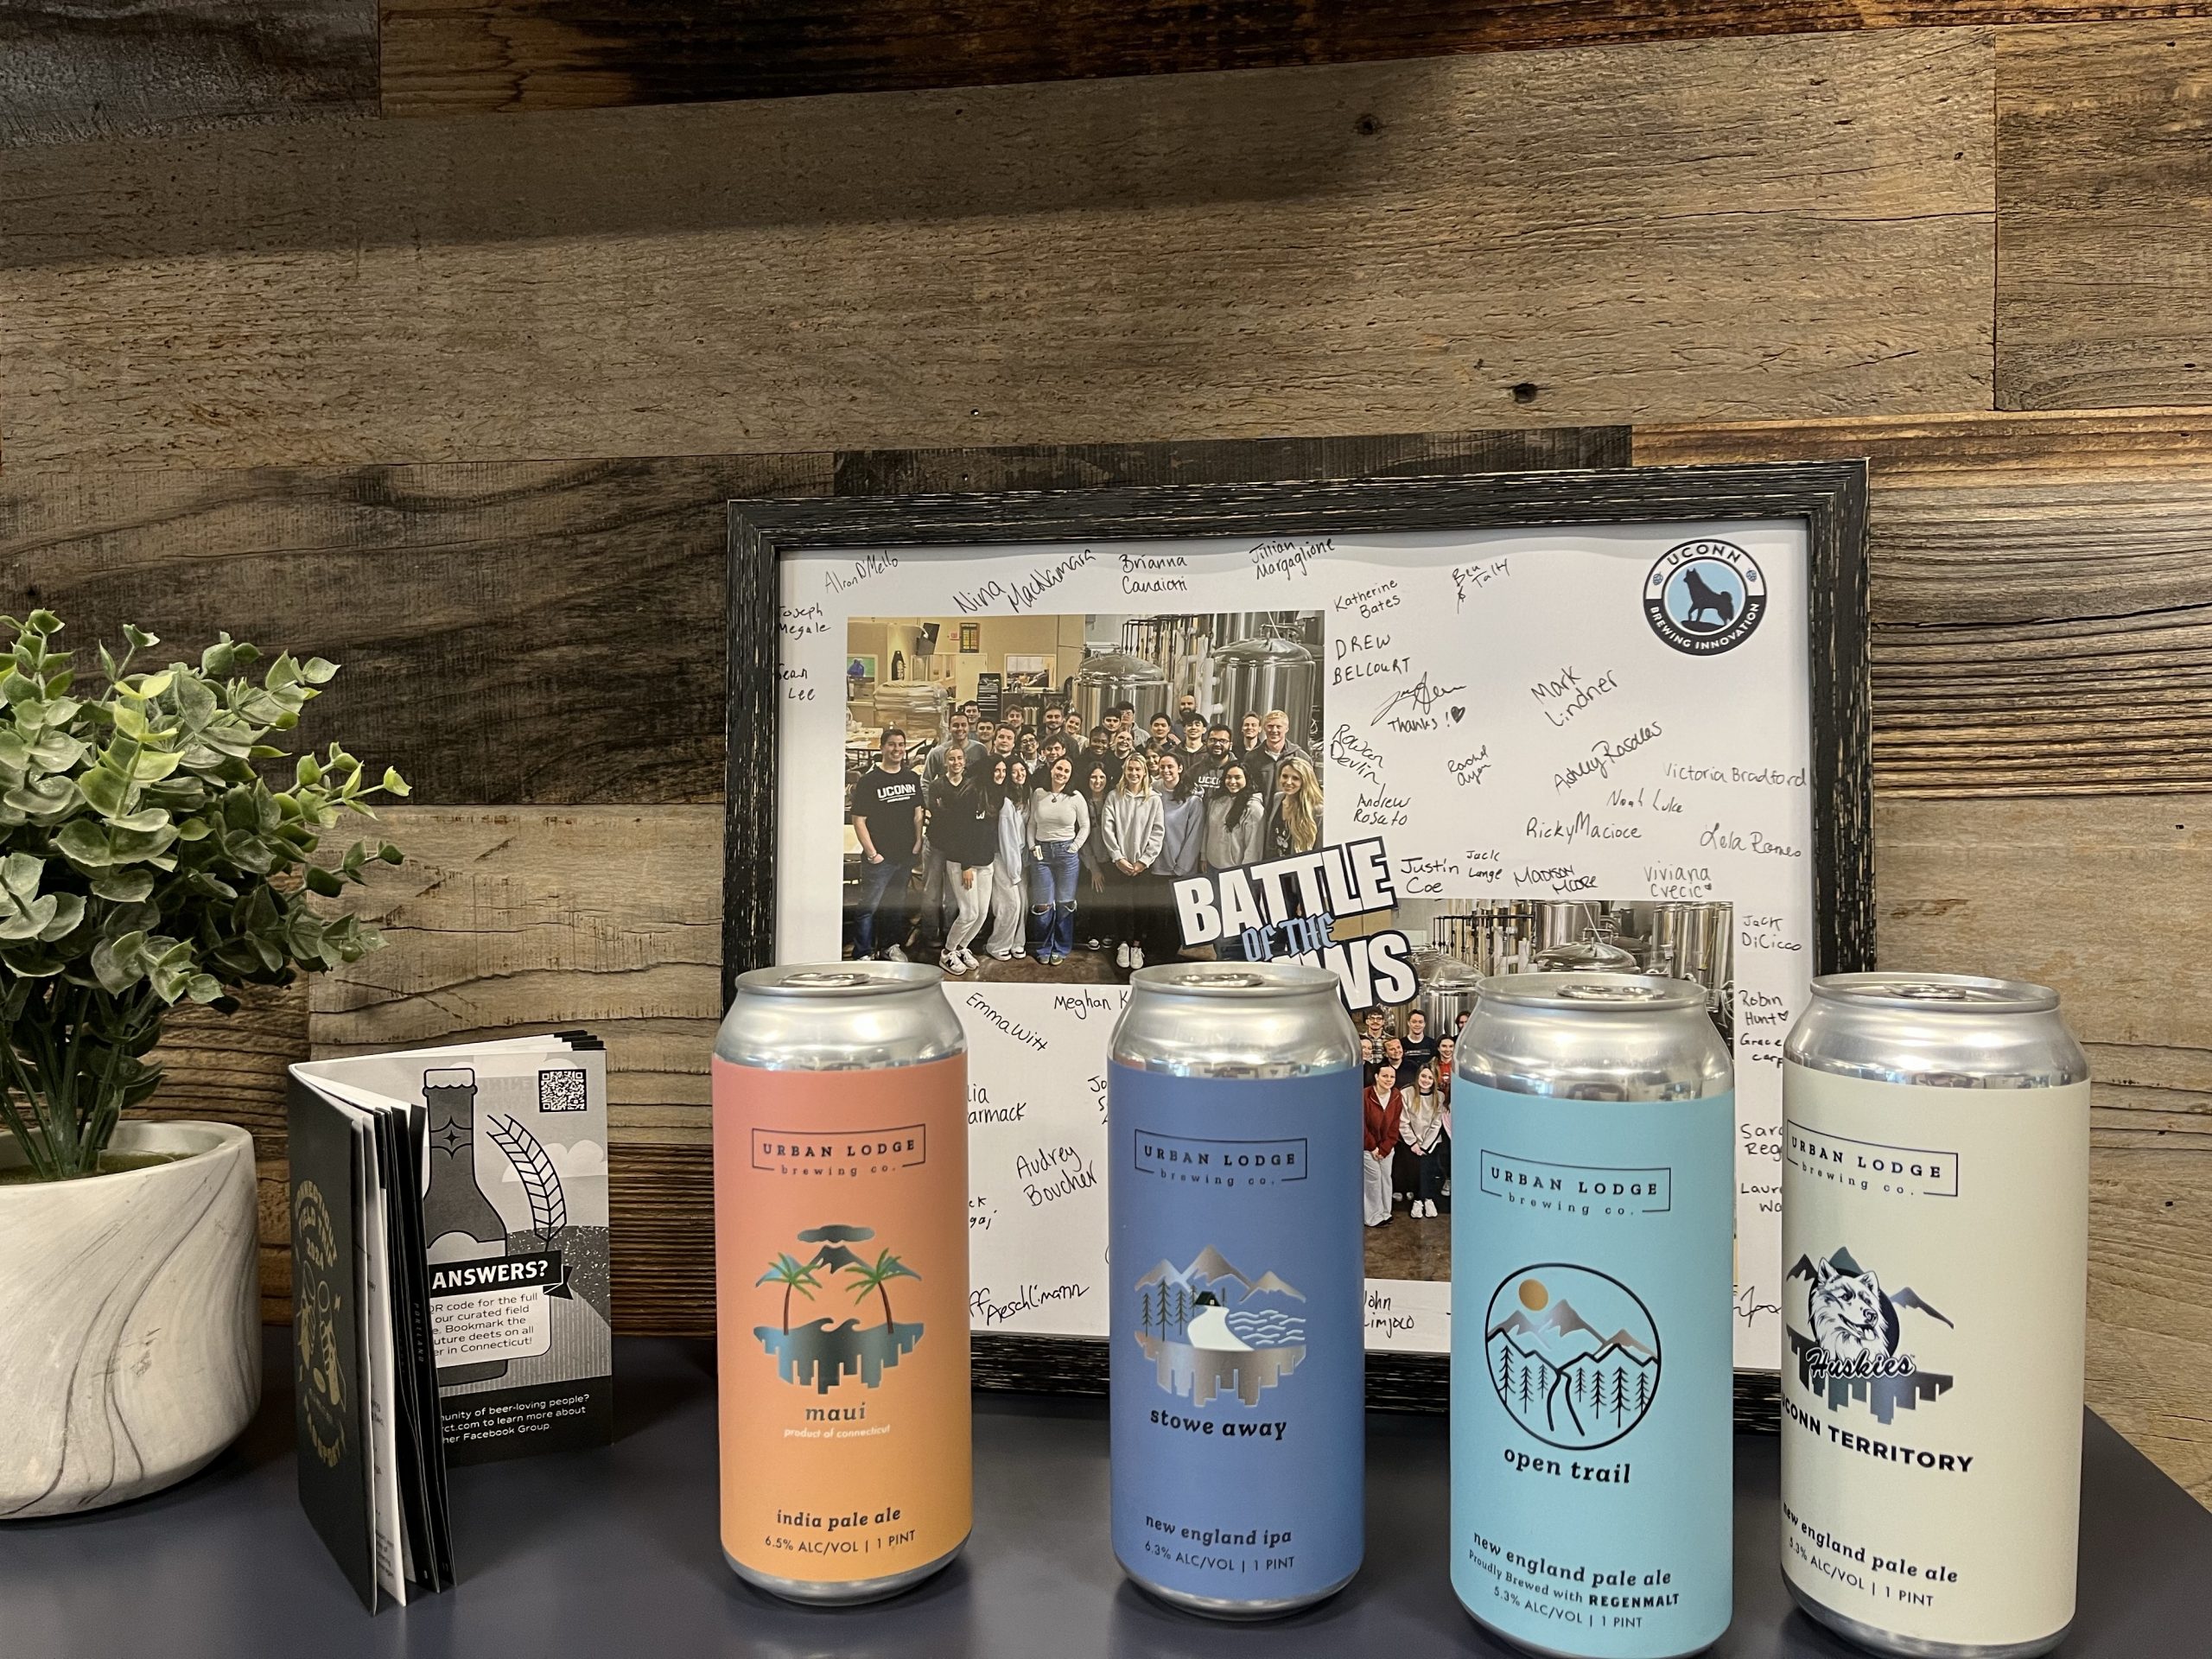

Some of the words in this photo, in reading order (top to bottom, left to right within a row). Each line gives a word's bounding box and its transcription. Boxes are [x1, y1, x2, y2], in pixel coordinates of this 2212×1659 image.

[1119, 554, 1187, 573] Brianna
[1667, 544, 1741, 565] UCONN
[953, 581, 1007, 613] Nina
[1334, 580, 1397, 612] Katherine
[1360, 594, 1400, 619] Bates
[779, 602, 823, 620] oseph
[1650, 607, 1691, 647] BREWING
[1695, 603, 1760, 649] INNOVATION
[1336, 634, 1390, 660] DREW
[789, 688, 816, 701] Lee
[1530, 666, 1581, 703] Mark
[1663, 762, 1728, 783] Victoria
[1732, 767, 1807, 786] Bradford
[877, 784, 916, 798] UCONN
[1401, 857, 1459, 874] Justin
[1644, 861, 1711, 882] Viviana
[1173, 840, 1394, 945] BATTLE
[1406, 877, 1443, 893] Coe
[1242, 925, 1277, 962] OF
[1278, 913, 1337, 955] THE
[1054, 988, 1111, 1020] Meghan
[1738, 989, 1783, 1007] Robin
[966, 992, 1009, 1034] Emma
[1012, 1024, 1048, 1052] Witt
[969, 1103, 1027, 1124] armack
[762, 1143, 832, 1157] URBAN
[848, 1140, 915, 1157] LODGE
[1145, 1145, 1210, 1165] URBAN
[1224, 1154, 1295, 1166] LODGE
[1792, 1136, 1843, 1163] URBAN
[1858, 1156, 1941, 1178] LODGE
[781, 1165, 857, 1177] brewing
[871, 1165, 896, 1173] co.
[1017, 1146, 1082, 1179] Audrey
[1023, 1160, 1097, 1206] Boucher
[1160, 1168, 1234, 1186] brewing
[1249, 1177, 1274, 1185] co.
[1491, 1166, 1562, 1191] URBAN
[1579, 1181, 1657, 1196] LODGE
[1802, 1161, 1868, 1191] brewing
[1884, 1184, 1914, 1195] co.
[1509, 1192, 1590, 1215] brewing
[1605, 1206, 1634, 1215] co.
[432, 1260, 548, 1290] ANSWERS?
[448, 1301, 474, 1310] code
[478, 1299, 494, 1307] for
[521, 1293, 537, 1302] full
[458, 1308, 501, 1320] curated
[505, 1305, 530, 1314] field
[434, 1336, 465, 1344] uture
[469, 1331, 501, 1340] deets
[446, 1319, 503, 1332] Bookmark
[461, 1337, 532, 1352] Connecticut!
[1806, 1347, 1916, 1379] Huskies
[475, 1408, 486, 1417] of
[489, 1401, 546, 1415] beer-loving
[549, 1394, 589, 1408] people?
[498, 1415, 523, 1425] learn
[526, 1412, 553, 1421] more
[556, 1407, 586, 1417] about
[805, 1402, 866, 1421] maui
[464, 1427, 515, 1440] Facebook
[784, 1427, 821, 1439] product
[823, 1427, 834, 1439] of
[836, 1425, 891, 1438] connecticut
[1150, 1409, 1213, 1434] stowe
[1223, 1421, 1287, 1440] away
[1828, 1425, 1974, 1472] TERRITORY
[1503, 1448, 1560, 1476] open
[1571, 1462, 1631, 1484] trail
[777, 1510, 822, 1528] india
[828, 1512, 868, 1531] pale
[874, 1507, 901, 1523] ale
[1146, 1515, 1176, 1534] new
[1181, 1528, 1256, 1547] england
[1263, 1529, 1292, 1548] ipa
[765, 1535, 793, 1551] 6.5%
[798, 1541, 858, 1555] ALC/VOL
[877, 1538, 880, 1548] 1
[888, 1529, 915, 1547] PINT
[1783, 1502, 1798, 1526] new
[1802, 1522, 1866, 1562] england
[1872, 1555, 1917, 1577] pale
[1926, 1567, 1958, 1583] ale
[1145, 1540, 1171, 1560] 6.3%
[1176, 1553, 1235, 1571] ALC/VOL
[1255, 1560, 1258, 1571] 1
[1267, 1556, 1294, 1570] PINT
[1474, 1532, 1501, 1555] new
[1507, 1550, 1585, 1582] england
[1592, 1571, 1637, 1588] pale
[1643, 1569, 1671, 1586] ale
[1469, 1549, 1502, 1580] Proudly
[1505, 1572, 1548, 1596] Brewed
[1554, 1588, 1583, 1603] with
[1589, 1593, 1680, 1608] REGENMALT
[1811, 1555, 1864, 1590] ALC/VOL
[1886, 1586, 1890, 1597] 1
[1899, 1590, 1934, 1607] PINT
[1493, 1586, 1521, 1606] 5.3%
[1524, 1599, 1583, 1624] ALC/VOL
[1602, 1616, 1605, 1626] 1
[1614, 1617, 1642, 1628] PINT
